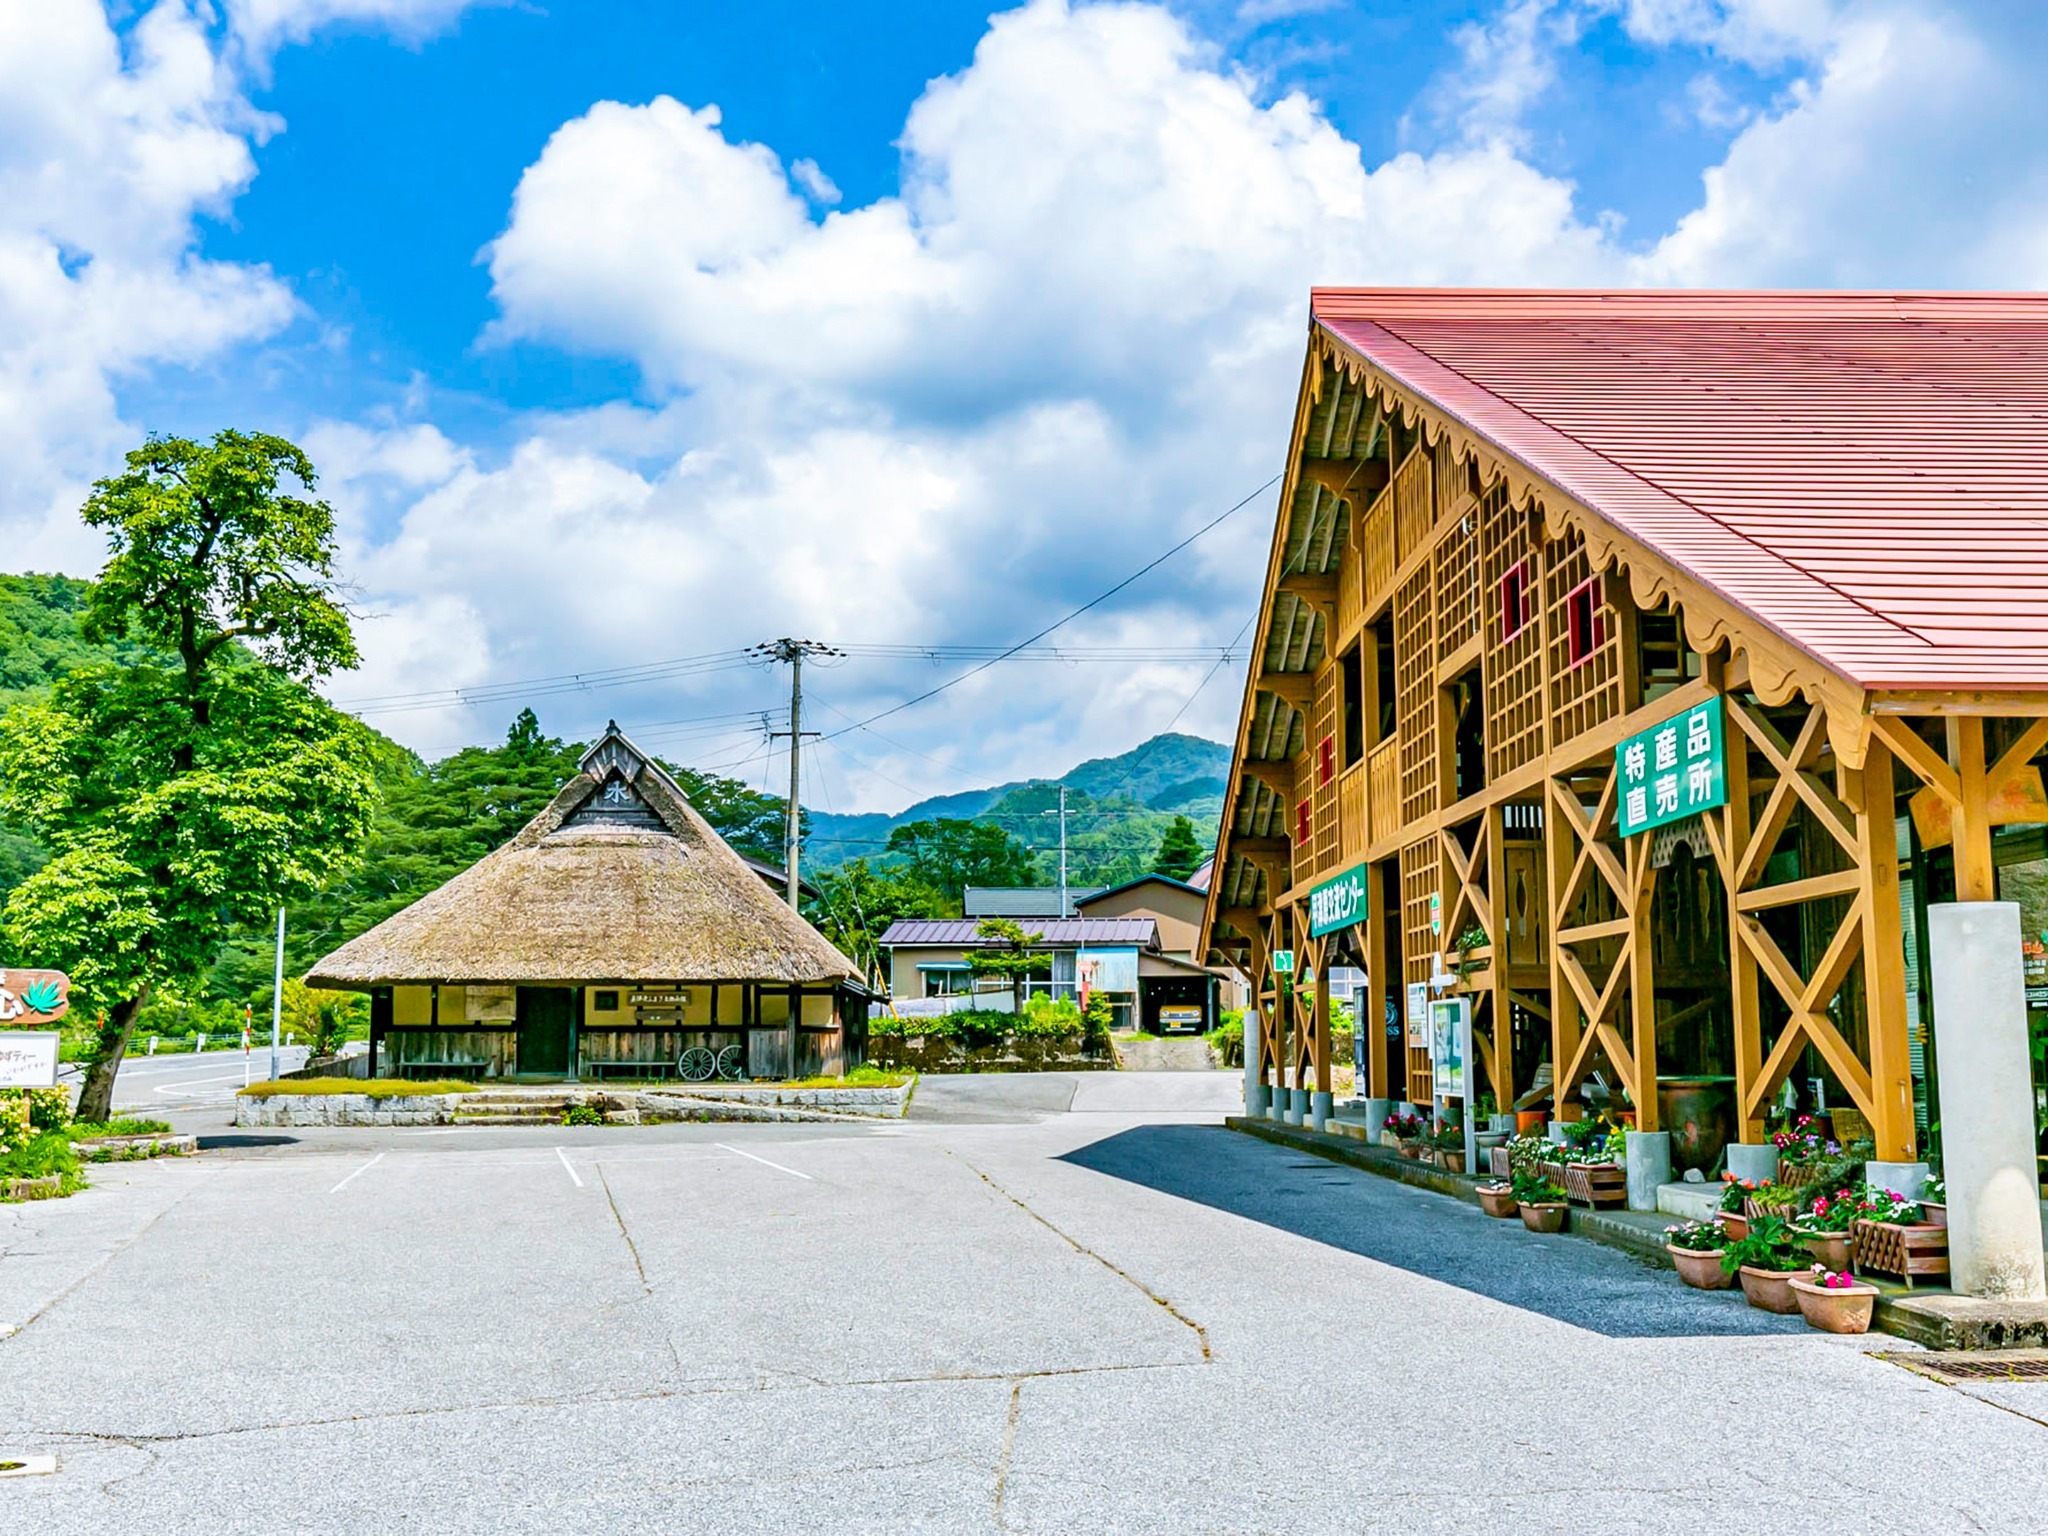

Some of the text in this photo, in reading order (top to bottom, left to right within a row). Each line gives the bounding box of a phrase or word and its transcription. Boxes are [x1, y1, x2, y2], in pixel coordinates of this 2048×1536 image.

[1624, 709, 1712, 784] 特産品
[603, 780, 630, 804] 水
[1625, 758, 1713, 828] 直売所
